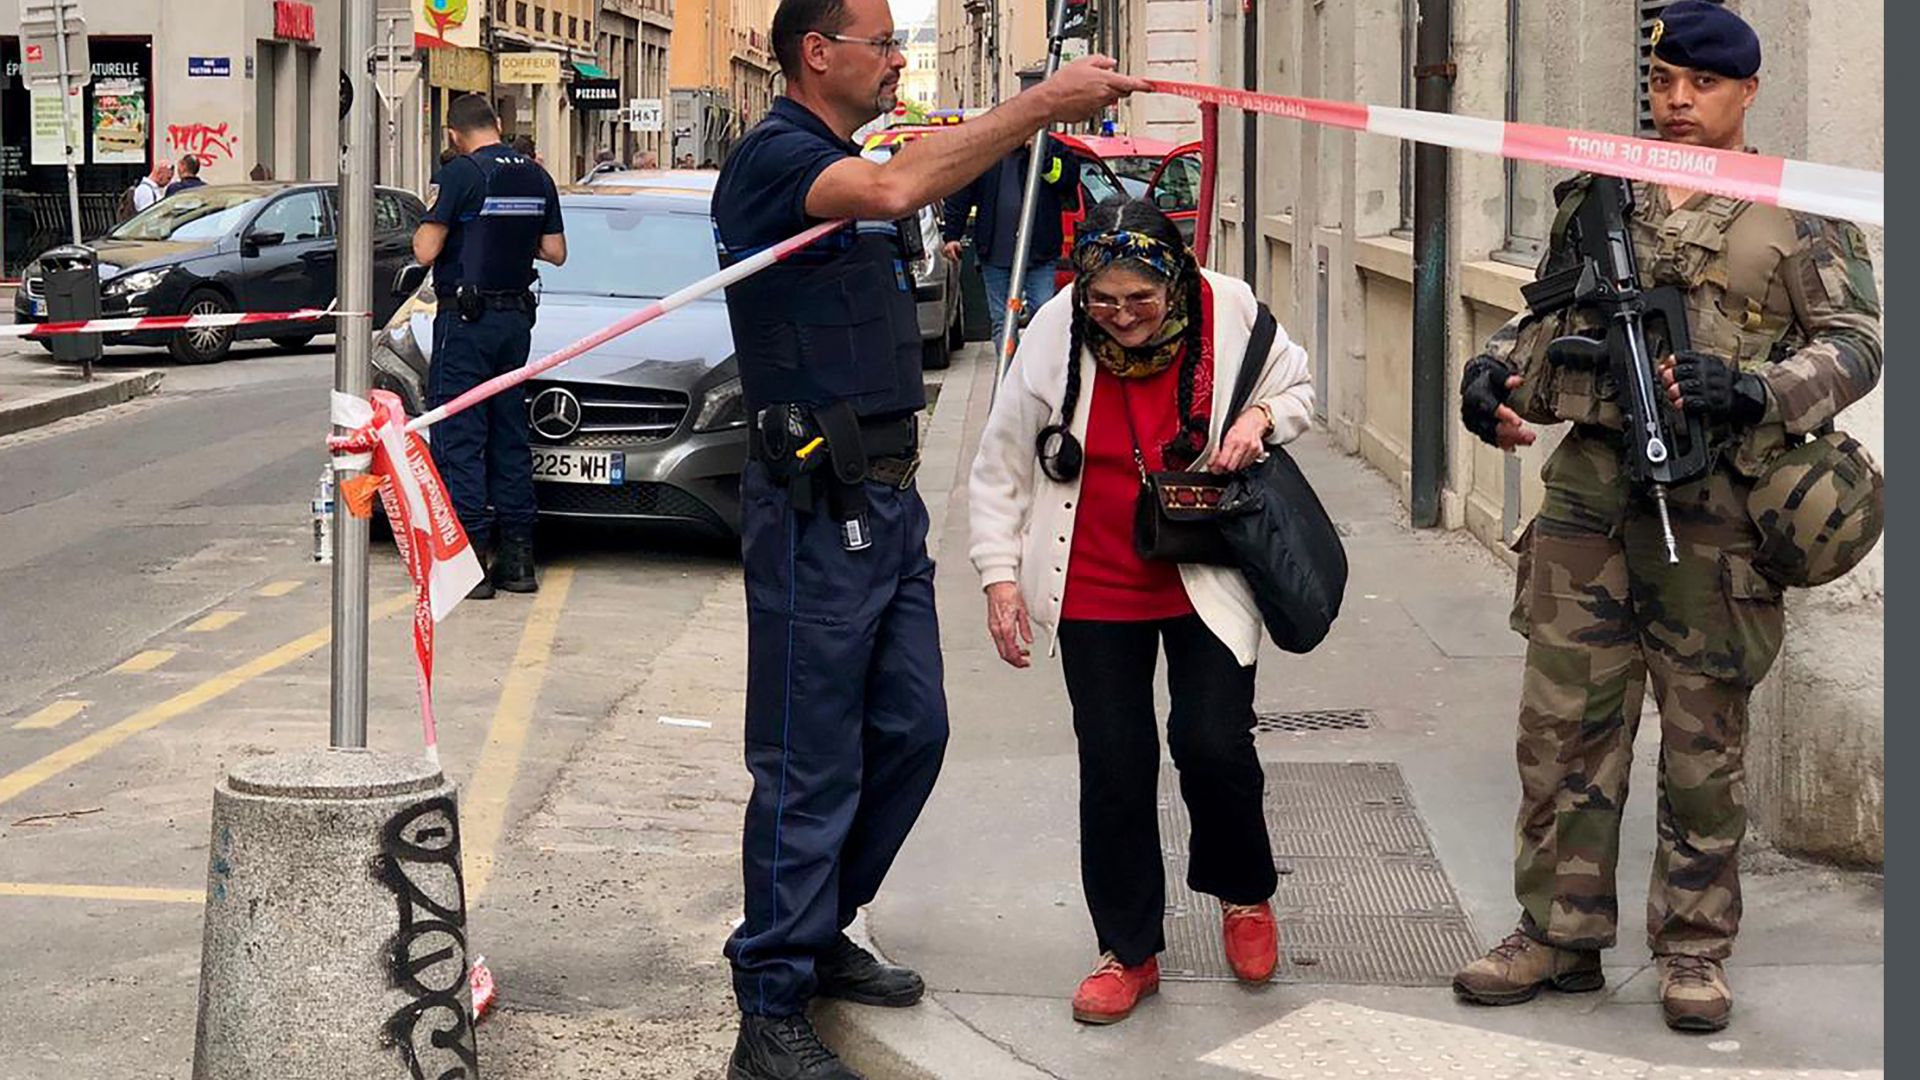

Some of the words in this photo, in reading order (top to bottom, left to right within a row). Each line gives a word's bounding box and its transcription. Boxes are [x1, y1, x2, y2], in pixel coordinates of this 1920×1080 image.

[91, 62, 140, 76] ATURELLE
[502, 57, 557, 69] COIFFEUR
[575, 88, 617, 99] PIZZERIA
